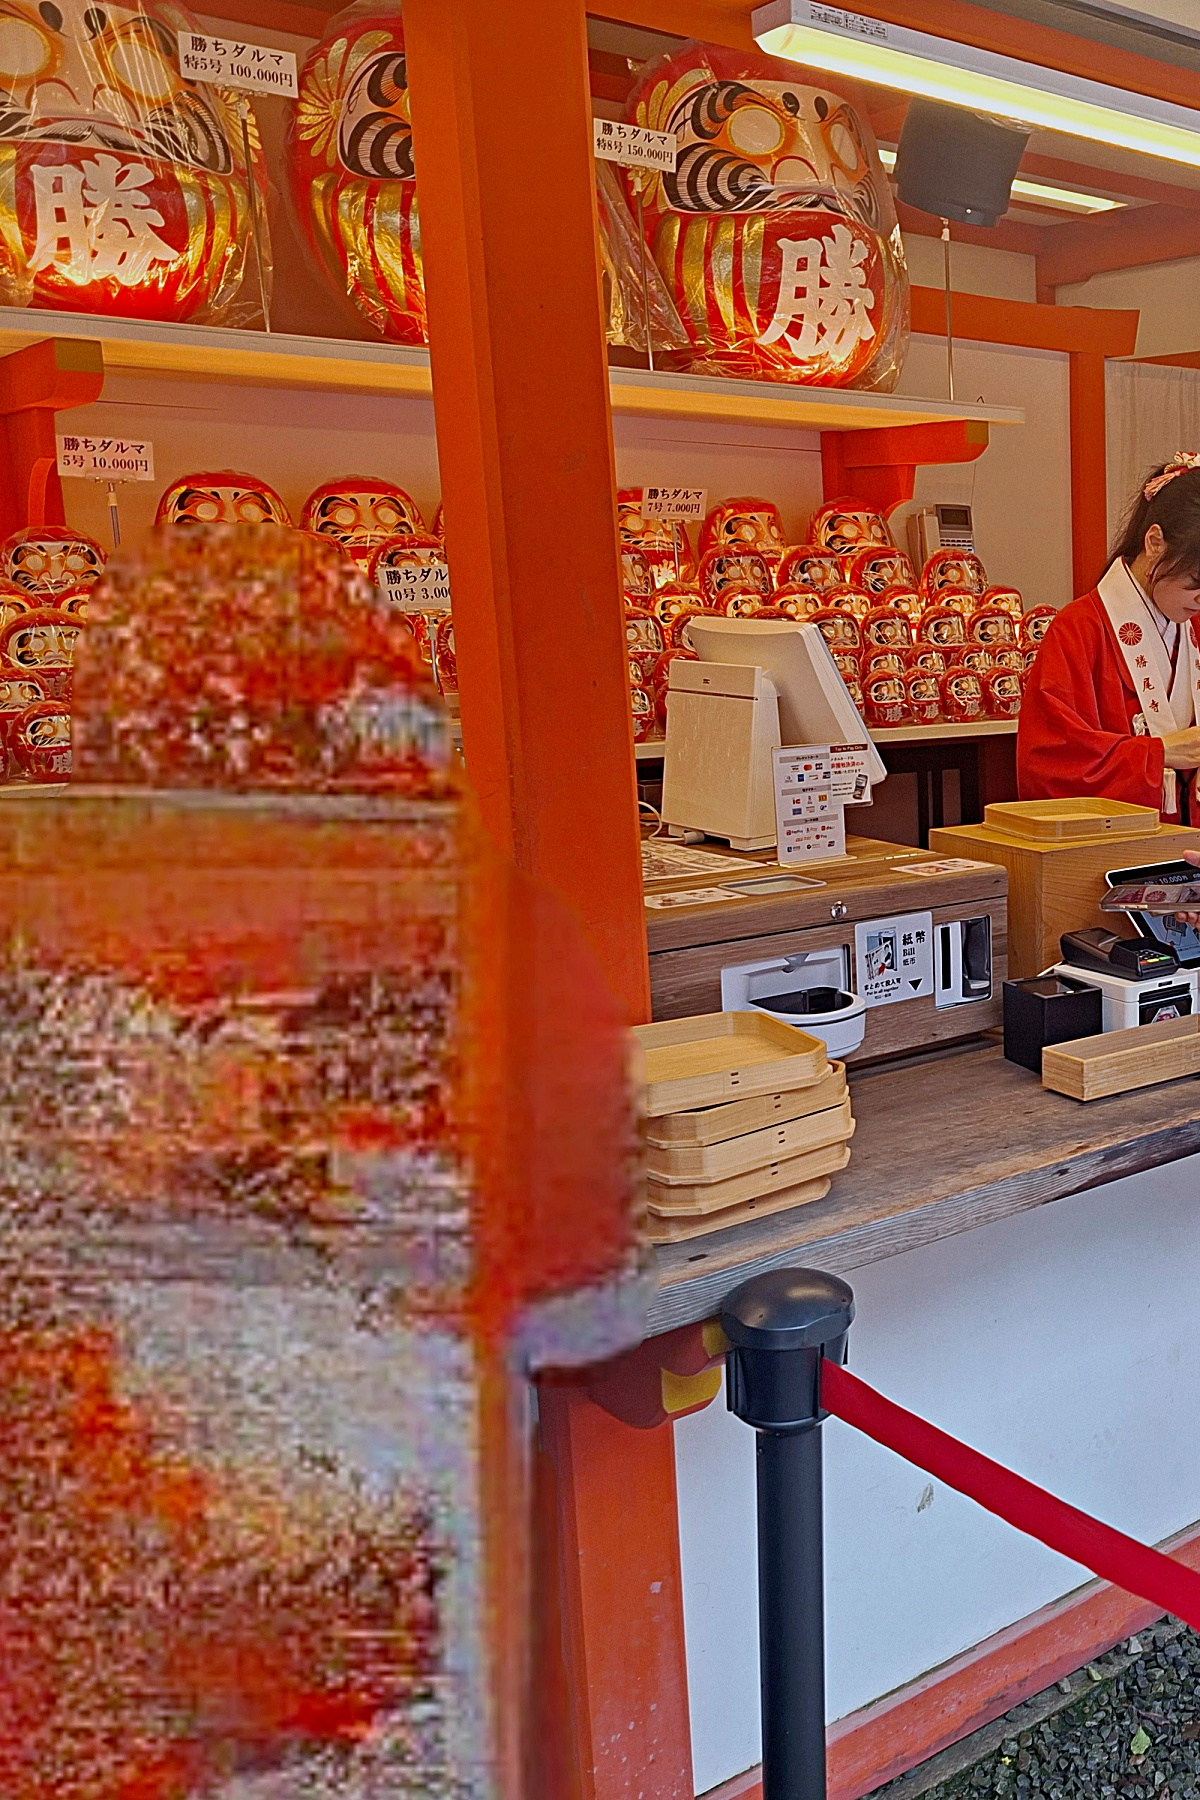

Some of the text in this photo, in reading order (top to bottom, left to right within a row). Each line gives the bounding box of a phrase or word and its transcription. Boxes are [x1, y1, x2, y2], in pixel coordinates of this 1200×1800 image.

[191, 36, 284, 66] 勝ちダルマ
[184, 54, 222, 74] 特5号
[601, 122, 668, 146] 勝ちダルマ
[596, 137, 623, 154] 特8号
[26, 153, 180, 286] 勝
[755, 224, 876, 362] 勝
[63, 437, 145, 454] 勝ちダルマ
[62, 455, 85, 468] 5号
[647, 488, 703, 500] 勝ちダルマ
[647, 502, 663, 513] 7号
[388, 588, 416, 601] 10号
[902, 930, 926, 946] 紙幣
[903, 947, 915, 957] Bill
